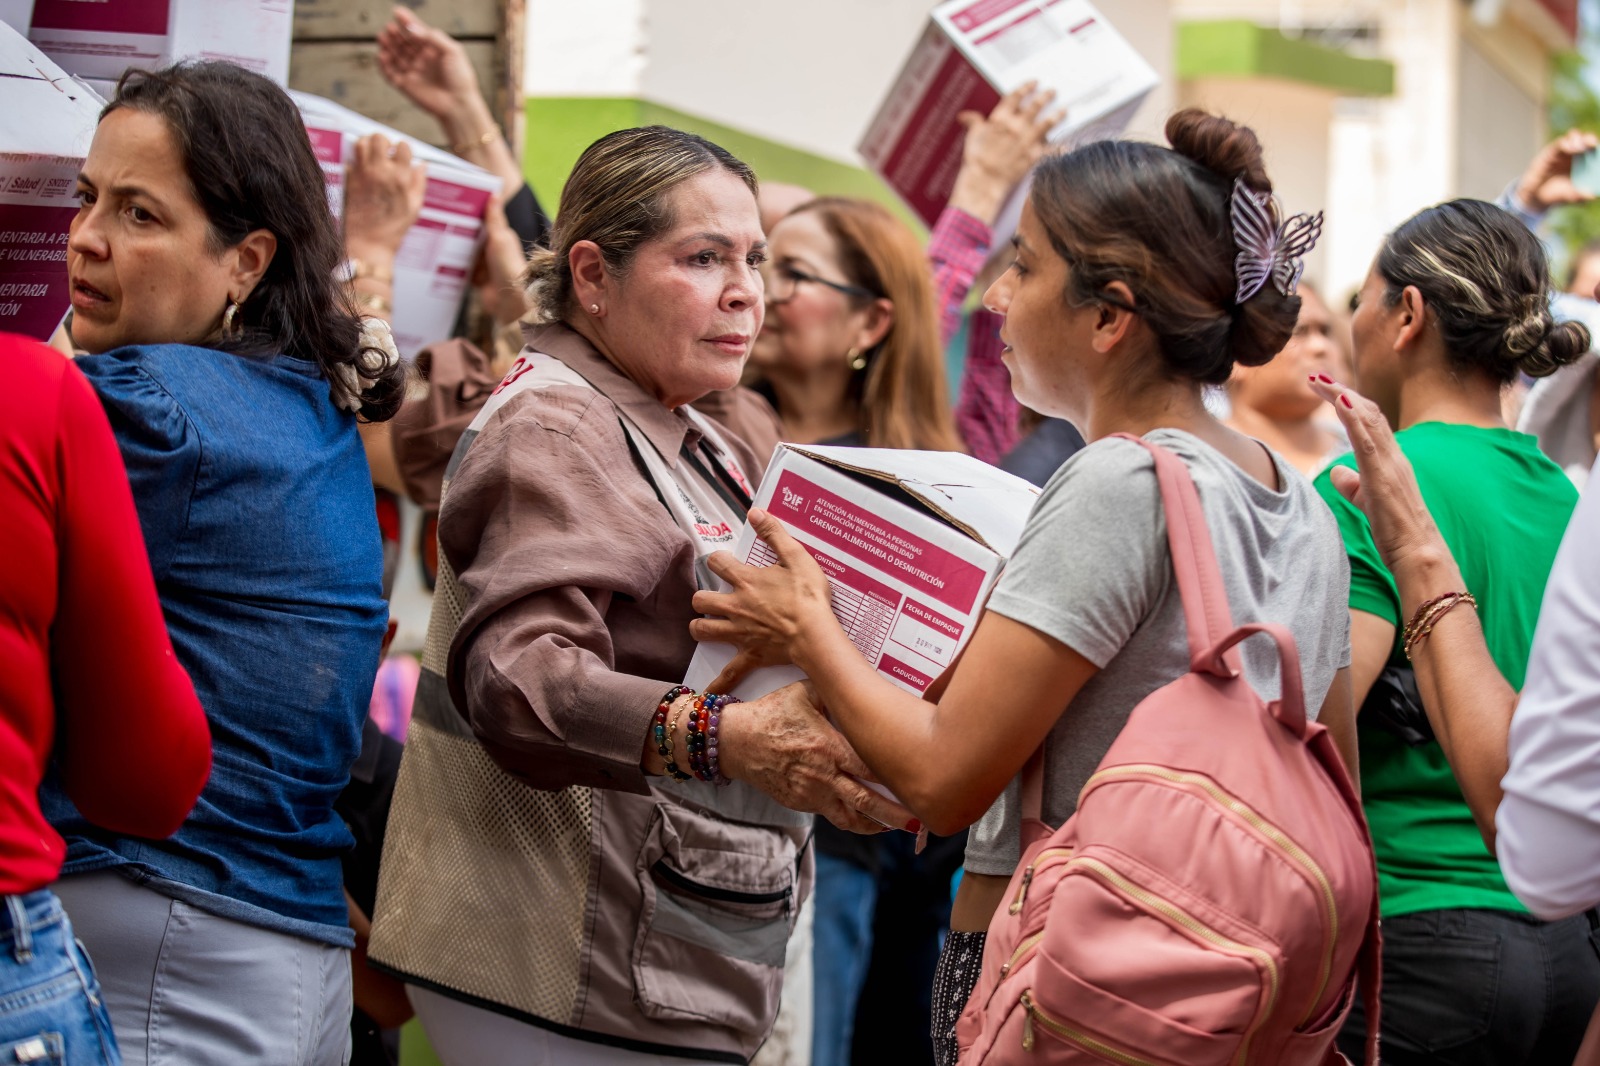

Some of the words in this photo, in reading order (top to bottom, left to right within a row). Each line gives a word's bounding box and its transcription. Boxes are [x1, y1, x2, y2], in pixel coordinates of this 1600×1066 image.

[11, 177, 41, 189] Salud
[45, 232, 56, 244] A
[783, 489, 804, 507] DIF
[813, 504, 822, 514] EN
[823, 509, 855, 530] SITUACIÓN
[855, 525, 864, 534] DE
[864, 530, 915, 560] VULNERABILIDAD
[816, 497, 847, 516] ATENCIÓN
[846, 513, 886, 537] ALIMENTARIA
[891, 534, 923, 556] PERSONAS
[809, 515, 842, 537] CARENCIA
[841, 532, 887, 560] ALIMENTARIA
[887, 555, 894, 563] O
[893, 558, 945, 589] DESNUTRICIÓN
[814, 553, 846, 573] CONTENIDO
[905, 603, 923, 616] FECHA
[923, 612, 932, 621] DE
[932, 617, 961, 635] EMPAQUE
[892, 666, 925, 686] CADUCIDAD
